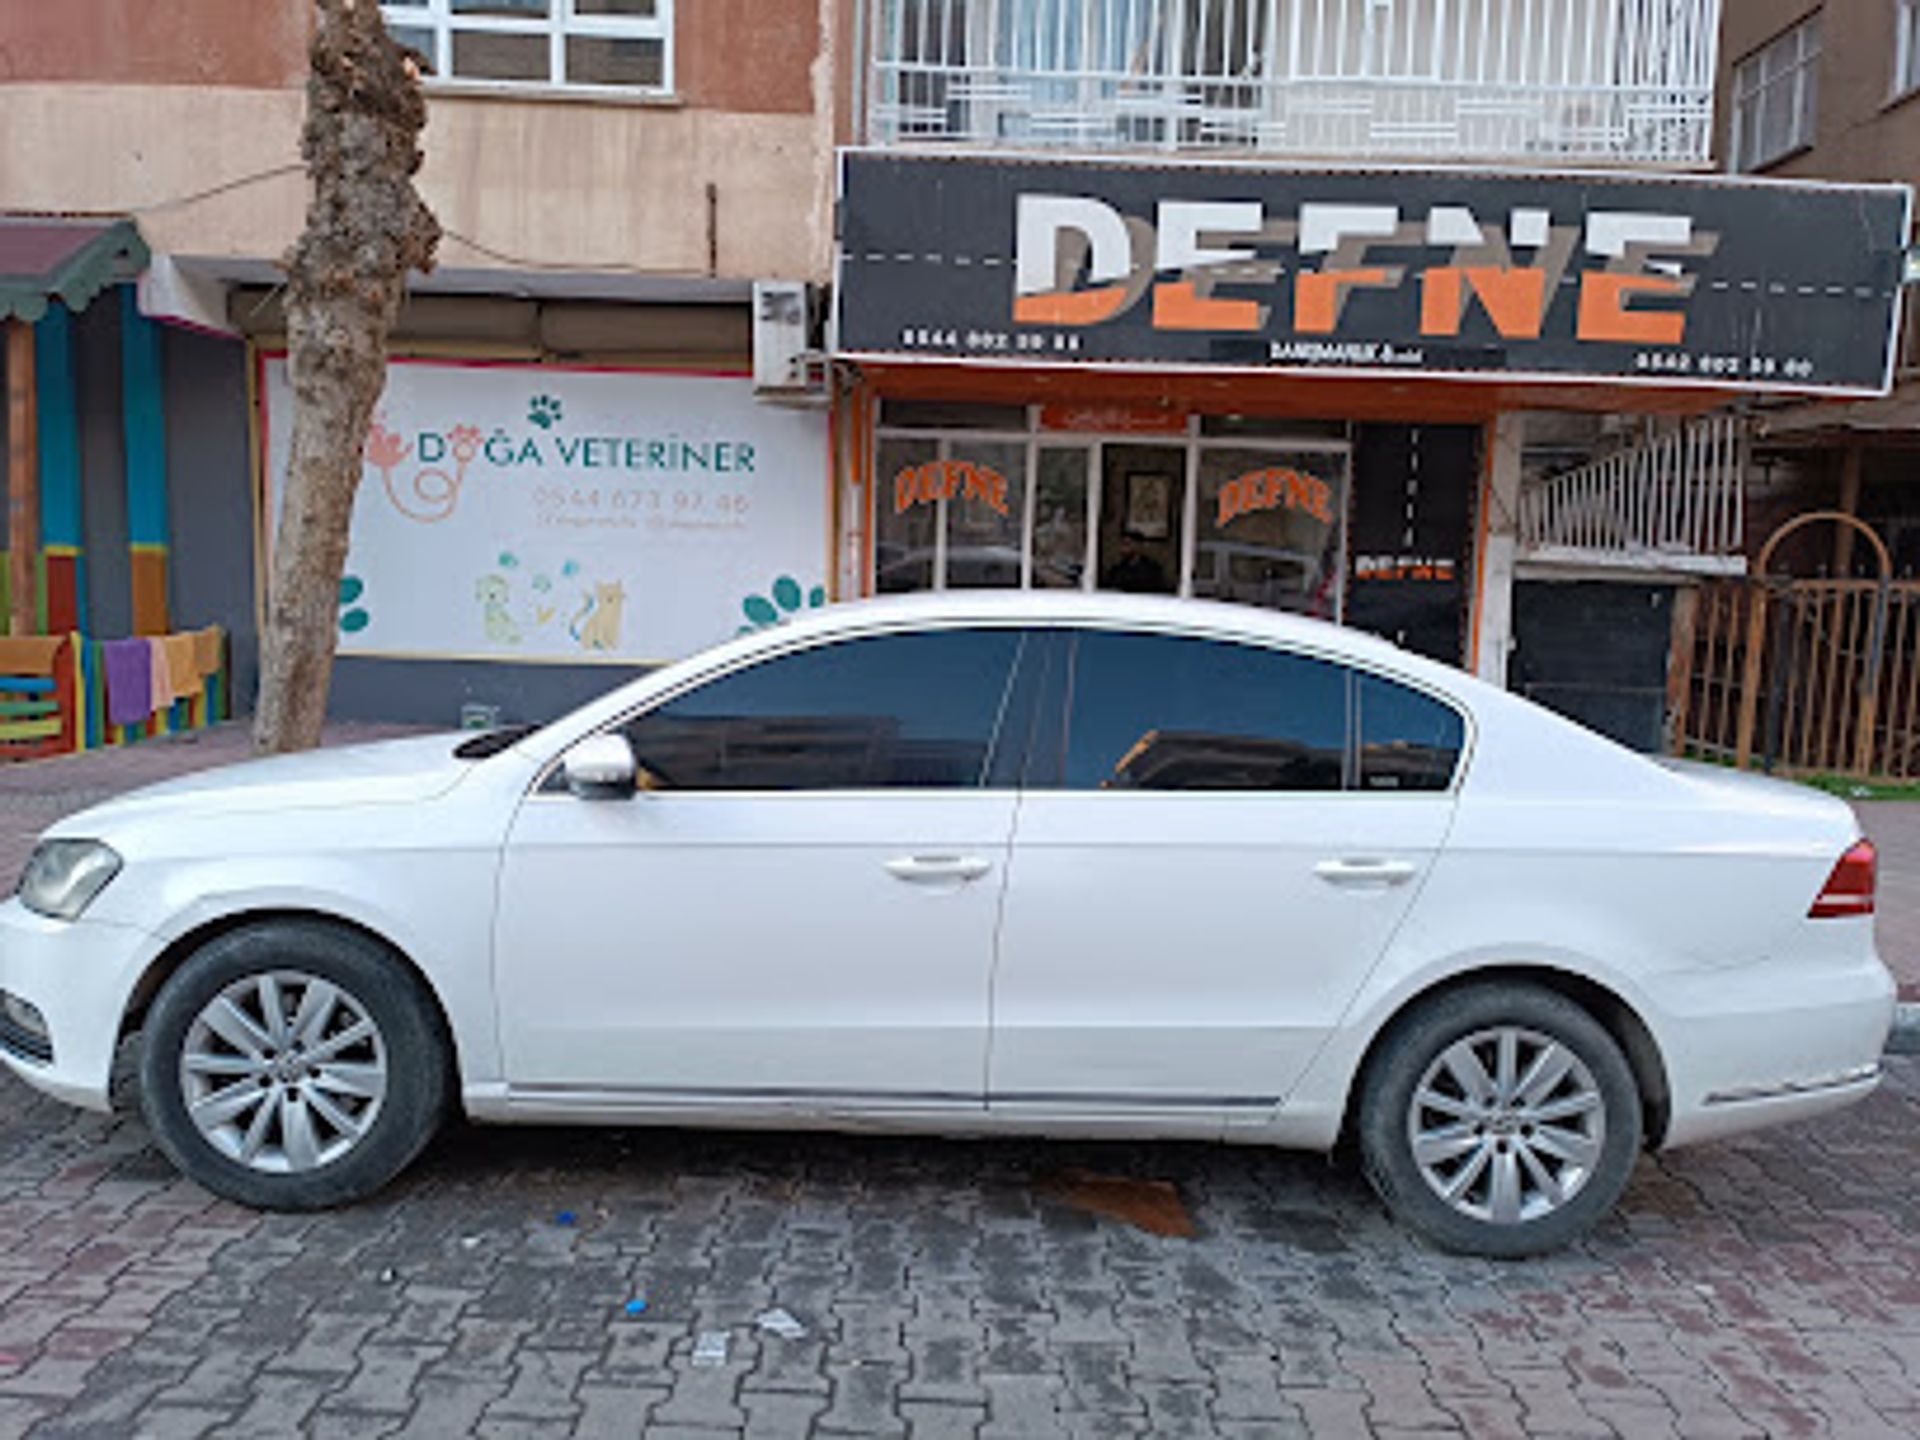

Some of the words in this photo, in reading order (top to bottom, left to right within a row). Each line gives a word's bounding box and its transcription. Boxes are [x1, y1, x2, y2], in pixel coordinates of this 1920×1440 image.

[1013, 193, 1692, 342] DEFNE
[418, 428, 544, 468] DOĞA
[555, 433, 756, 473] VETERİNER
[895, 460, 1009, 517] DEFNE
[1215, 467, 1333, 527] DEFNE
[1355, 555, 1456, 581] DEFNE
